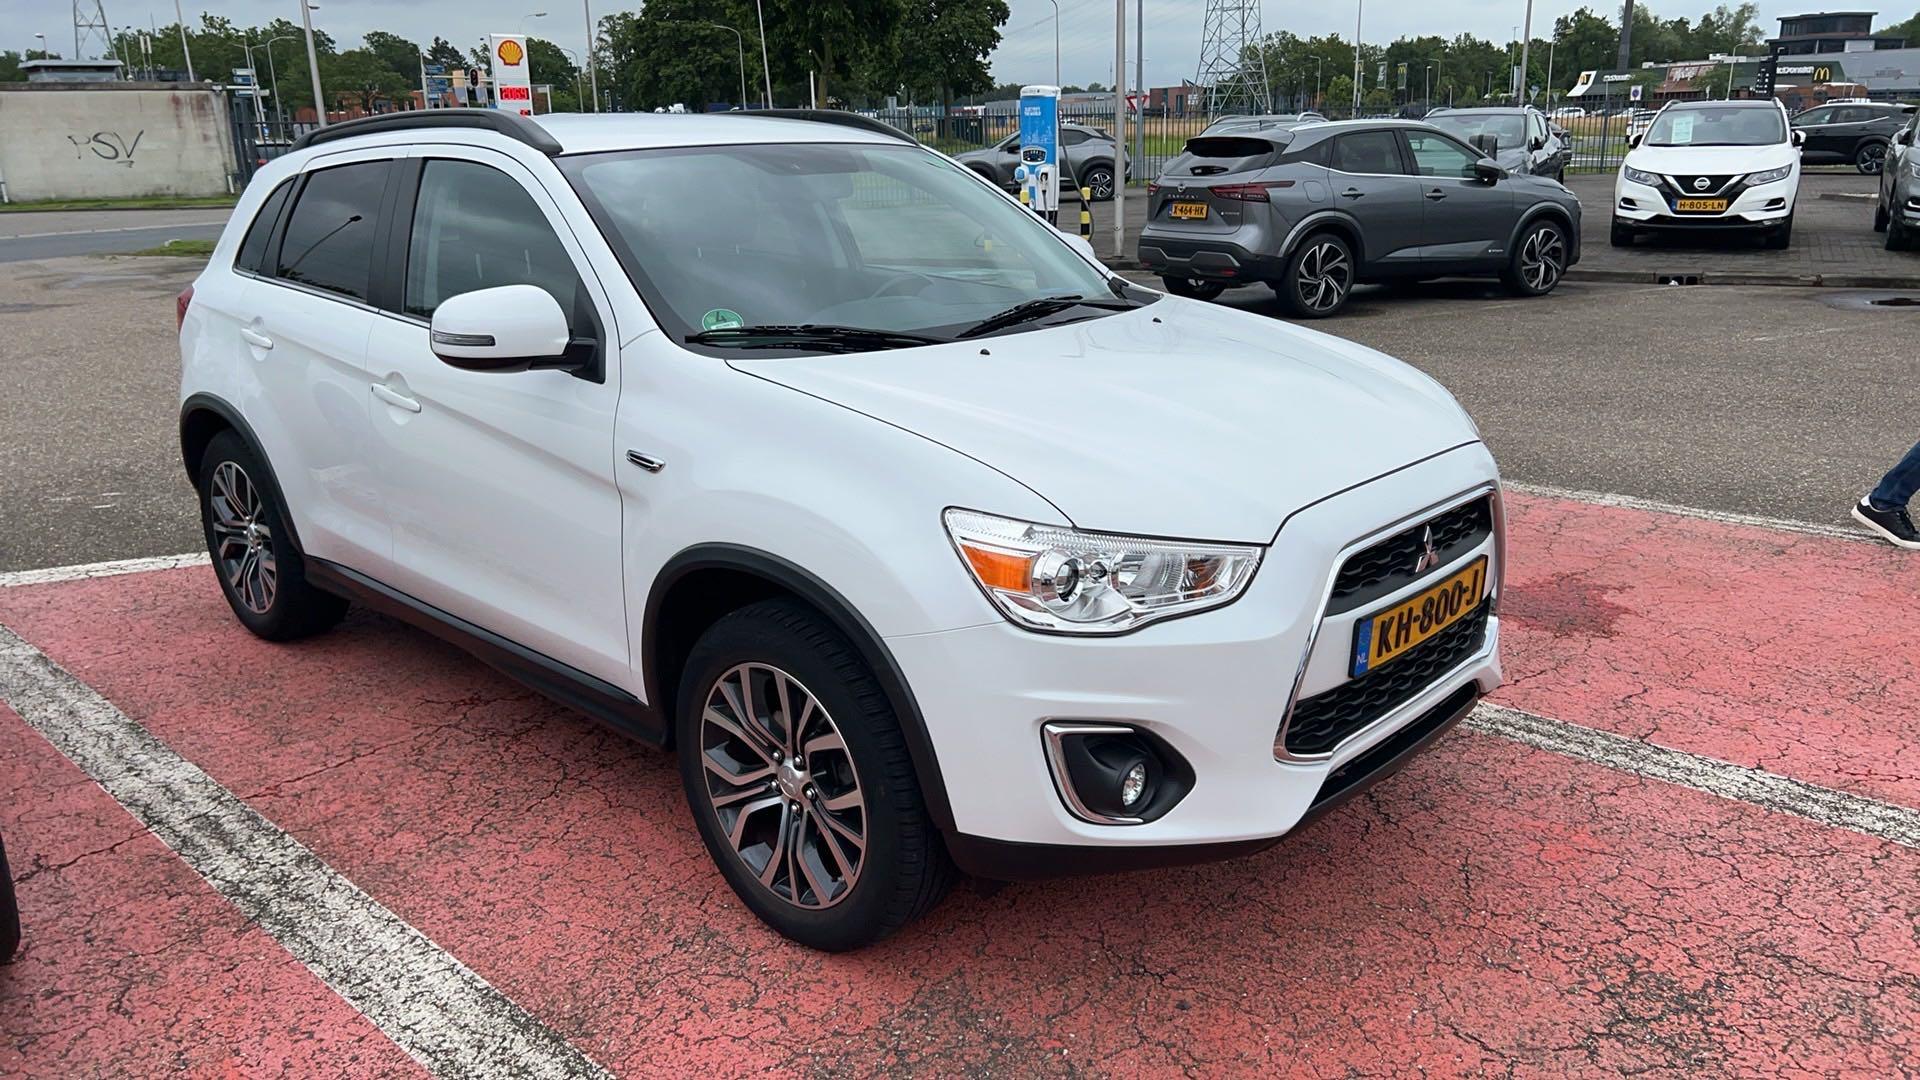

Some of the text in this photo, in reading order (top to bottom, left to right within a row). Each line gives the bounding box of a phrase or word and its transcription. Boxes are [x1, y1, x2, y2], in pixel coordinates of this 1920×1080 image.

[67, 130, 144, 160] PSV
[1679, 201, 1724, 209] H-805-LN
[1376, 569, 1480, 658] KH-800-J
